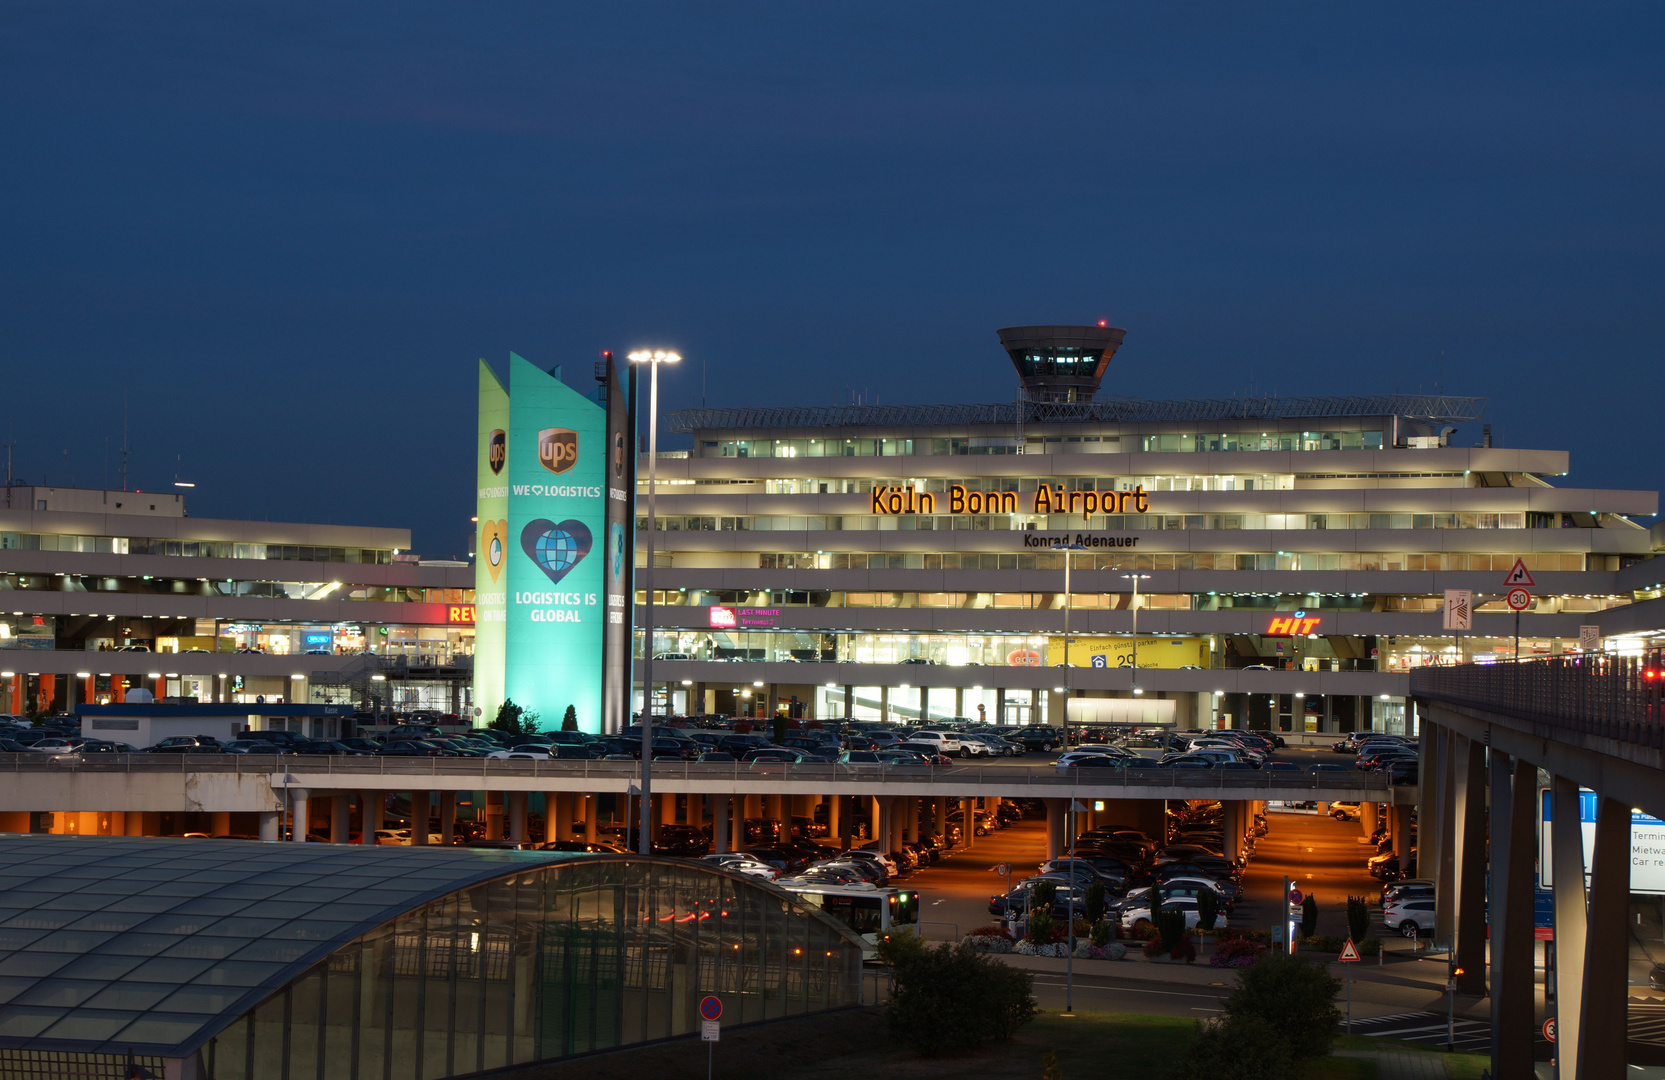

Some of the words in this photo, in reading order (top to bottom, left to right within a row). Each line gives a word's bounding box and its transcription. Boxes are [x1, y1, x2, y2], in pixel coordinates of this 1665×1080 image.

[490, 443, 505, 469] ups
[541, 442, 576, 468] ups
[513, 485, 530, 496] WE
[545, 485, 601, 498] LOGISTICS
[872, 484, 935, 514] Köln
[950, 484, 1018, 514] Bonn
[1034, 483, 1149, 520] Airport
[1024, 534, 1070, 547] Konrad
[1075, 534, 1139, 547] Adenauer
[478, 592, 506, 605] LOGISTICS
[516, 592, 581, 605] LOGISTICS
[584, 593, 597, 606] IS
[1512, 594, 1526, 604] 30
[530, 609, 581, 623] GLOBAL
[1267, 617, 1321, 635] HIT
[1114, 642, 1134, 650] günsti
[324, 706, 338, 715] Kasse
[1632, 857, 1649, 866] Car
